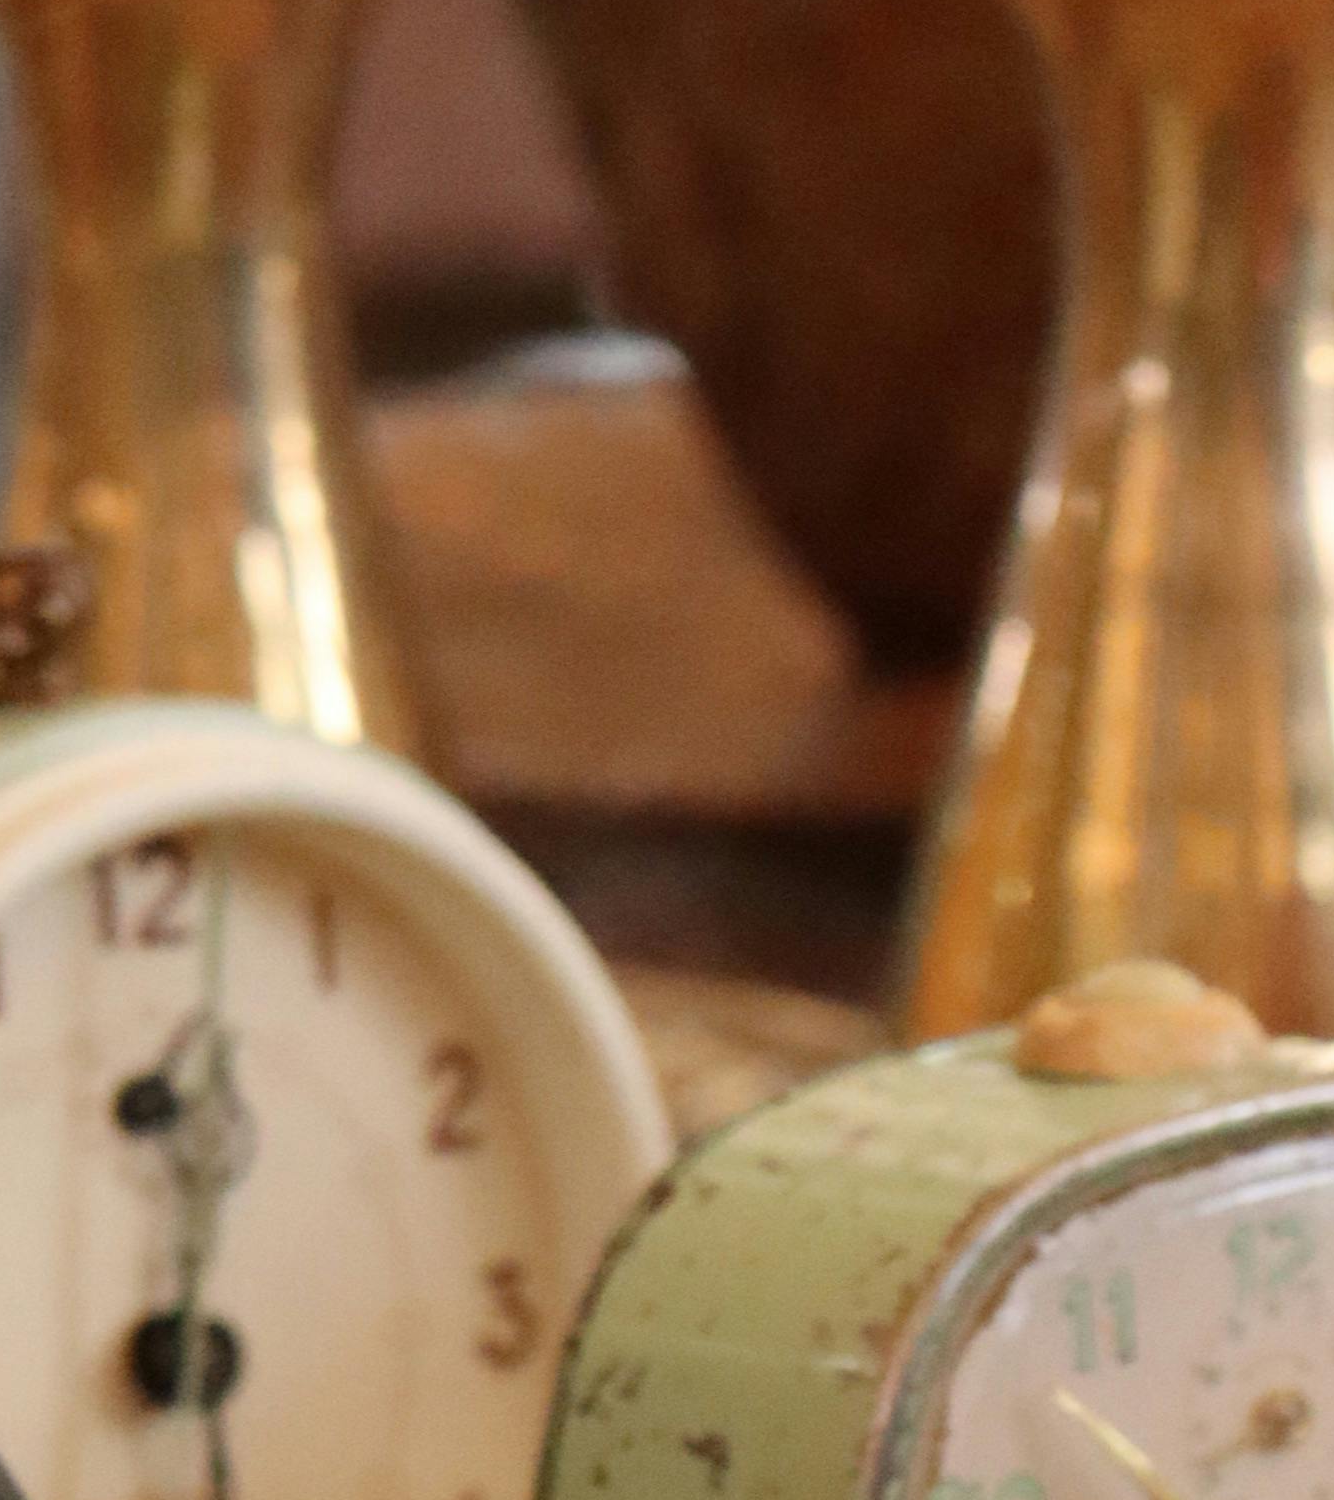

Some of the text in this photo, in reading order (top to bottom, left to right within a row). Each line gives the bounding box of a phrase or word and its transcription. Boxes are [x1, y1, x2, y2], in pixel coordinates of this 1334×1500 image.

[86, 832, 193, 947] 12
[311, 893, 339, 991] 1
[431, 1043, 483, 1154] 2
[1224, 1211, 1314, 1306] 12
[479, 1259, 535, 1372] 3
[1064, 1262, 1139, 1372] 11
